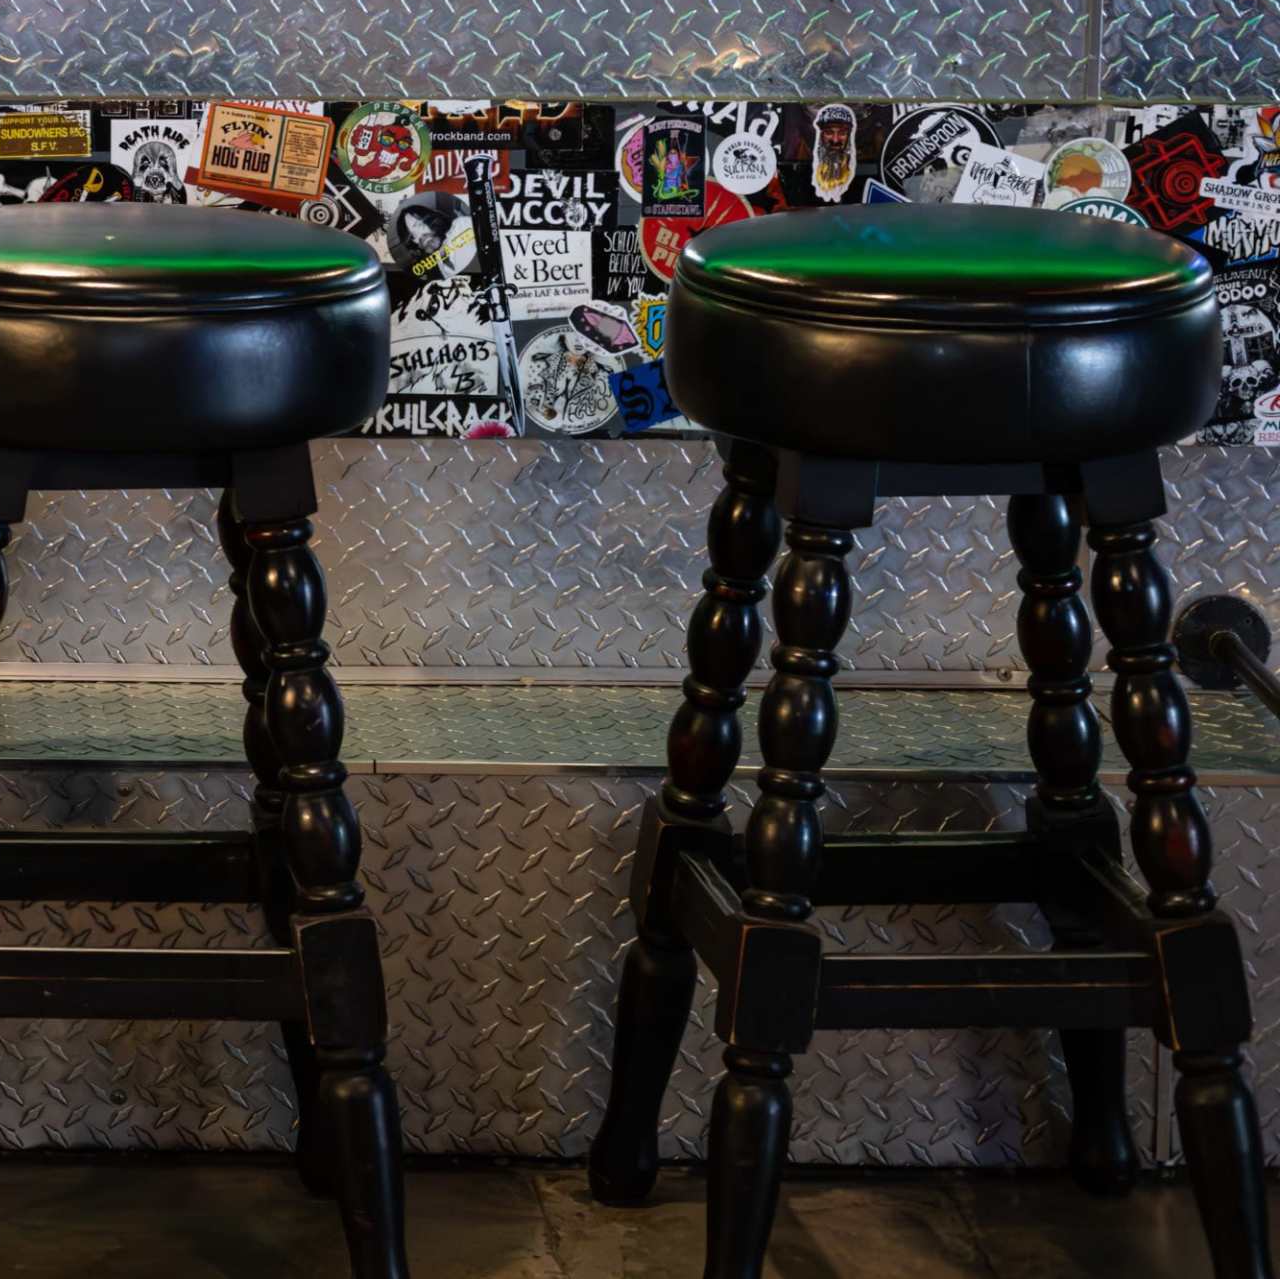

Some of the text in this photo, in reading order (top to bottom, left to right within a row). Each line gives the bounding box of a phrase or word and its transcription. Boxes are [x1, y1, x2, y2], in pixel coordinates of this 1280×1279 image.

[0, 127, 69, 140] SUNDOWNERS
[119, 124, 191, 152] DEATH RIDE
[891, 116, 965, 179] BRAINSPOON
[211, 145, 272, 174] HOG RUB
[722, 164, 768, 177] SULTANA
[499, 172, 606, 199] DEVIL
[1204, 181, 1251, 198] SHADOW
[496, 201, 612, 227] MCCOY
[1221, 198, 1272, 211] BREWING
[505, 232, 571, 258] Weed
[513, 258, 584, 283] & Beer
[609, 253, 648, 274] BELIEVES
[561, 286, 590, 296] Cheers
[627, 276, 645, 298] YOU
[468, 341, 490, 362] 13
